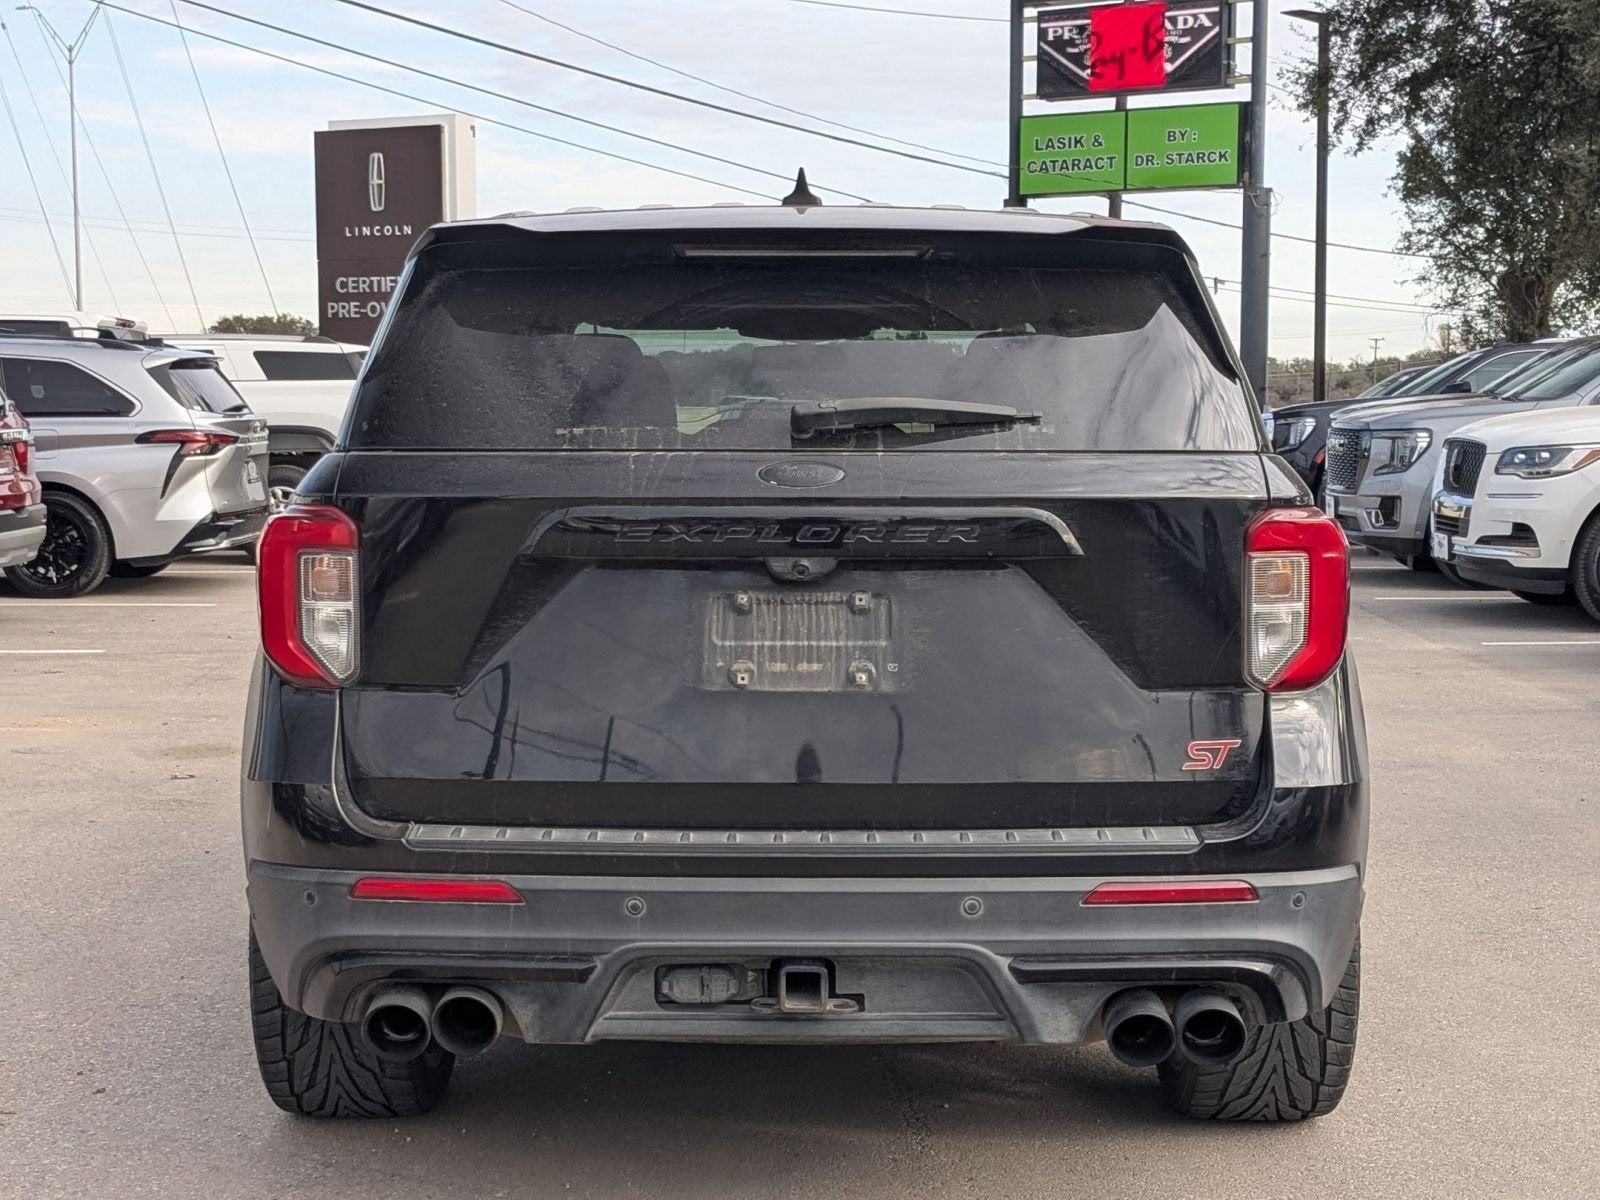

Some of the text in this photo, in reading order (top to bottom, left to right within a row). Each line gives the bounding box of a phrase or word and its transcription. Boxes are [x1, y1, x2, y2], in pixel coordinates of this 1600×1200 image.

[1034, 133, 1104, 152] LASIK &
[1026, 155, 1117, 174] CATARACT
[1134, 150, 1230, 167] DR. STARCK
[345, 225, 412, 237] LINCOLN
[335, 276, 401, 293] CERTIF
[613, 522, 982, 544] EXPLORER
[1182, 739, 1242, 770] ST
